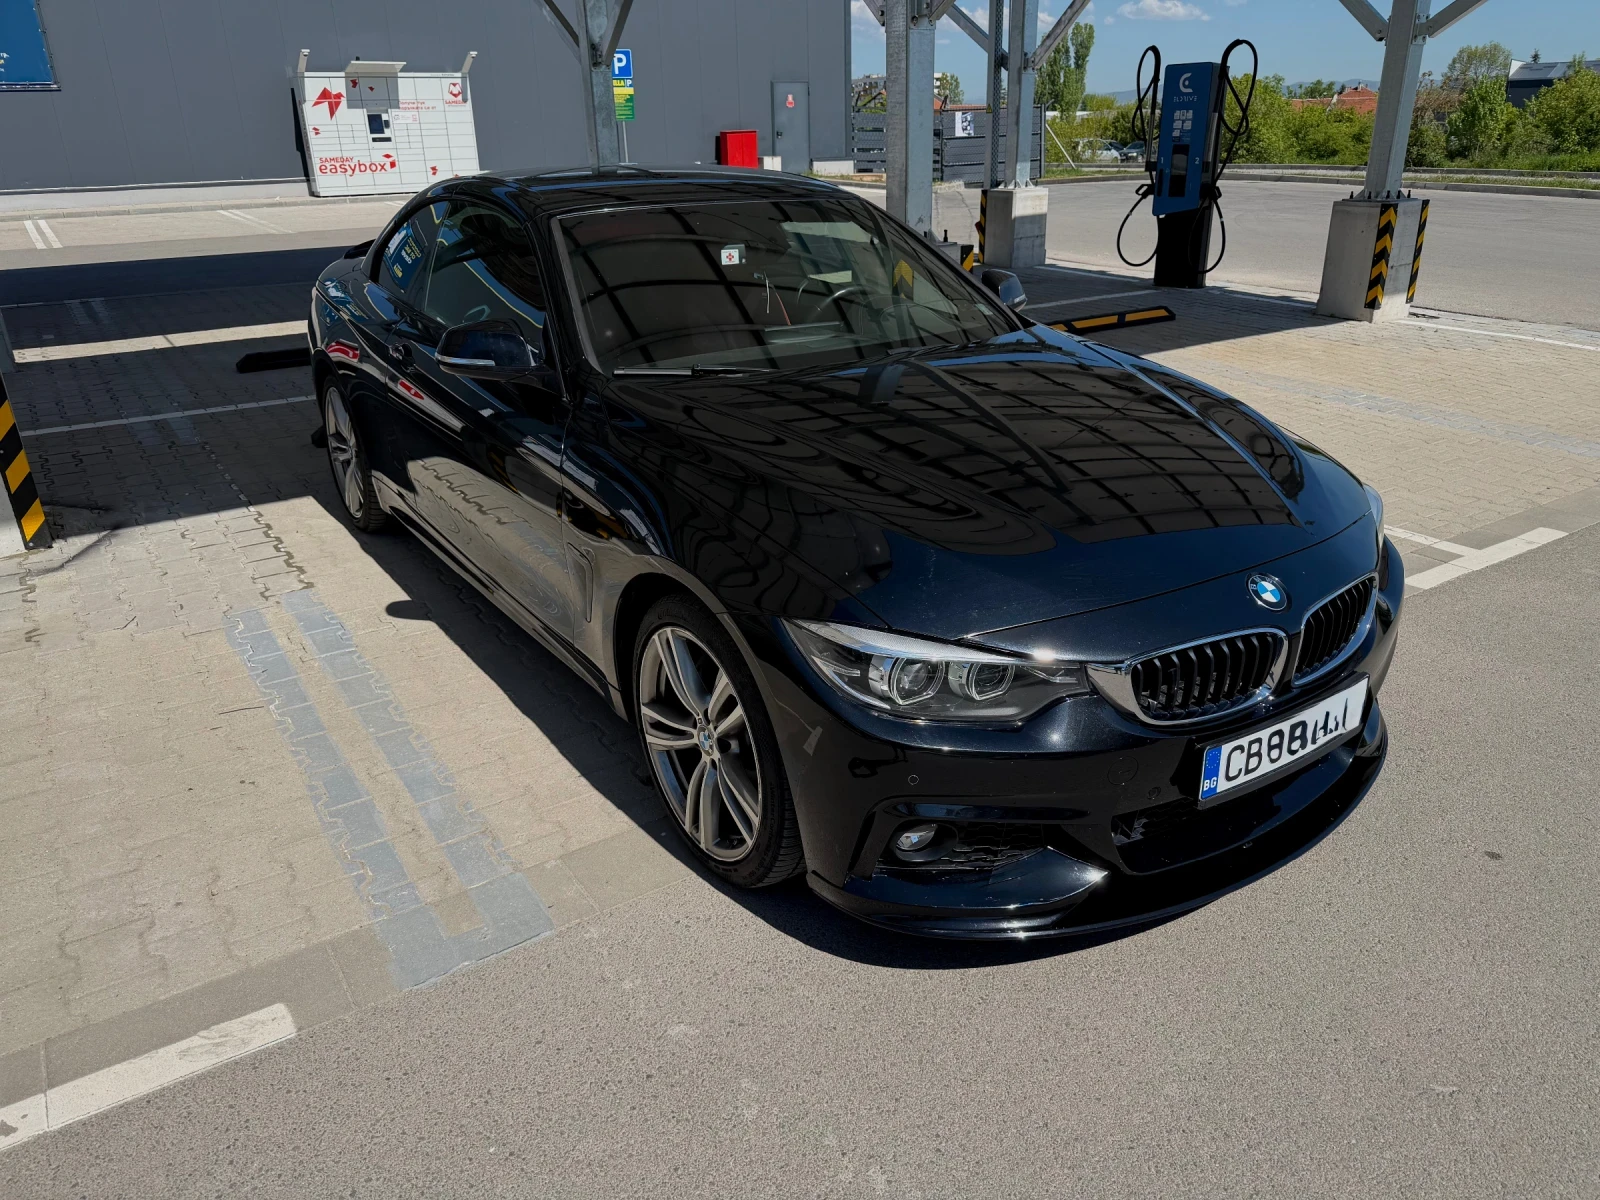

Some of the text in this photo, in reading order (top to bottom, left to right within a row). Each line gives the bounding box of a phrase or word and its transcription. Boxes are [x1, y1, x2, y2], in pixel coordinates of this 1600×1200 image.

[613, 53, 627, 74] P
[318, 159, 388, 177] easybox
[1160, 156, 1164, 164] 1
[1203, 776, 1218, 791] BG
